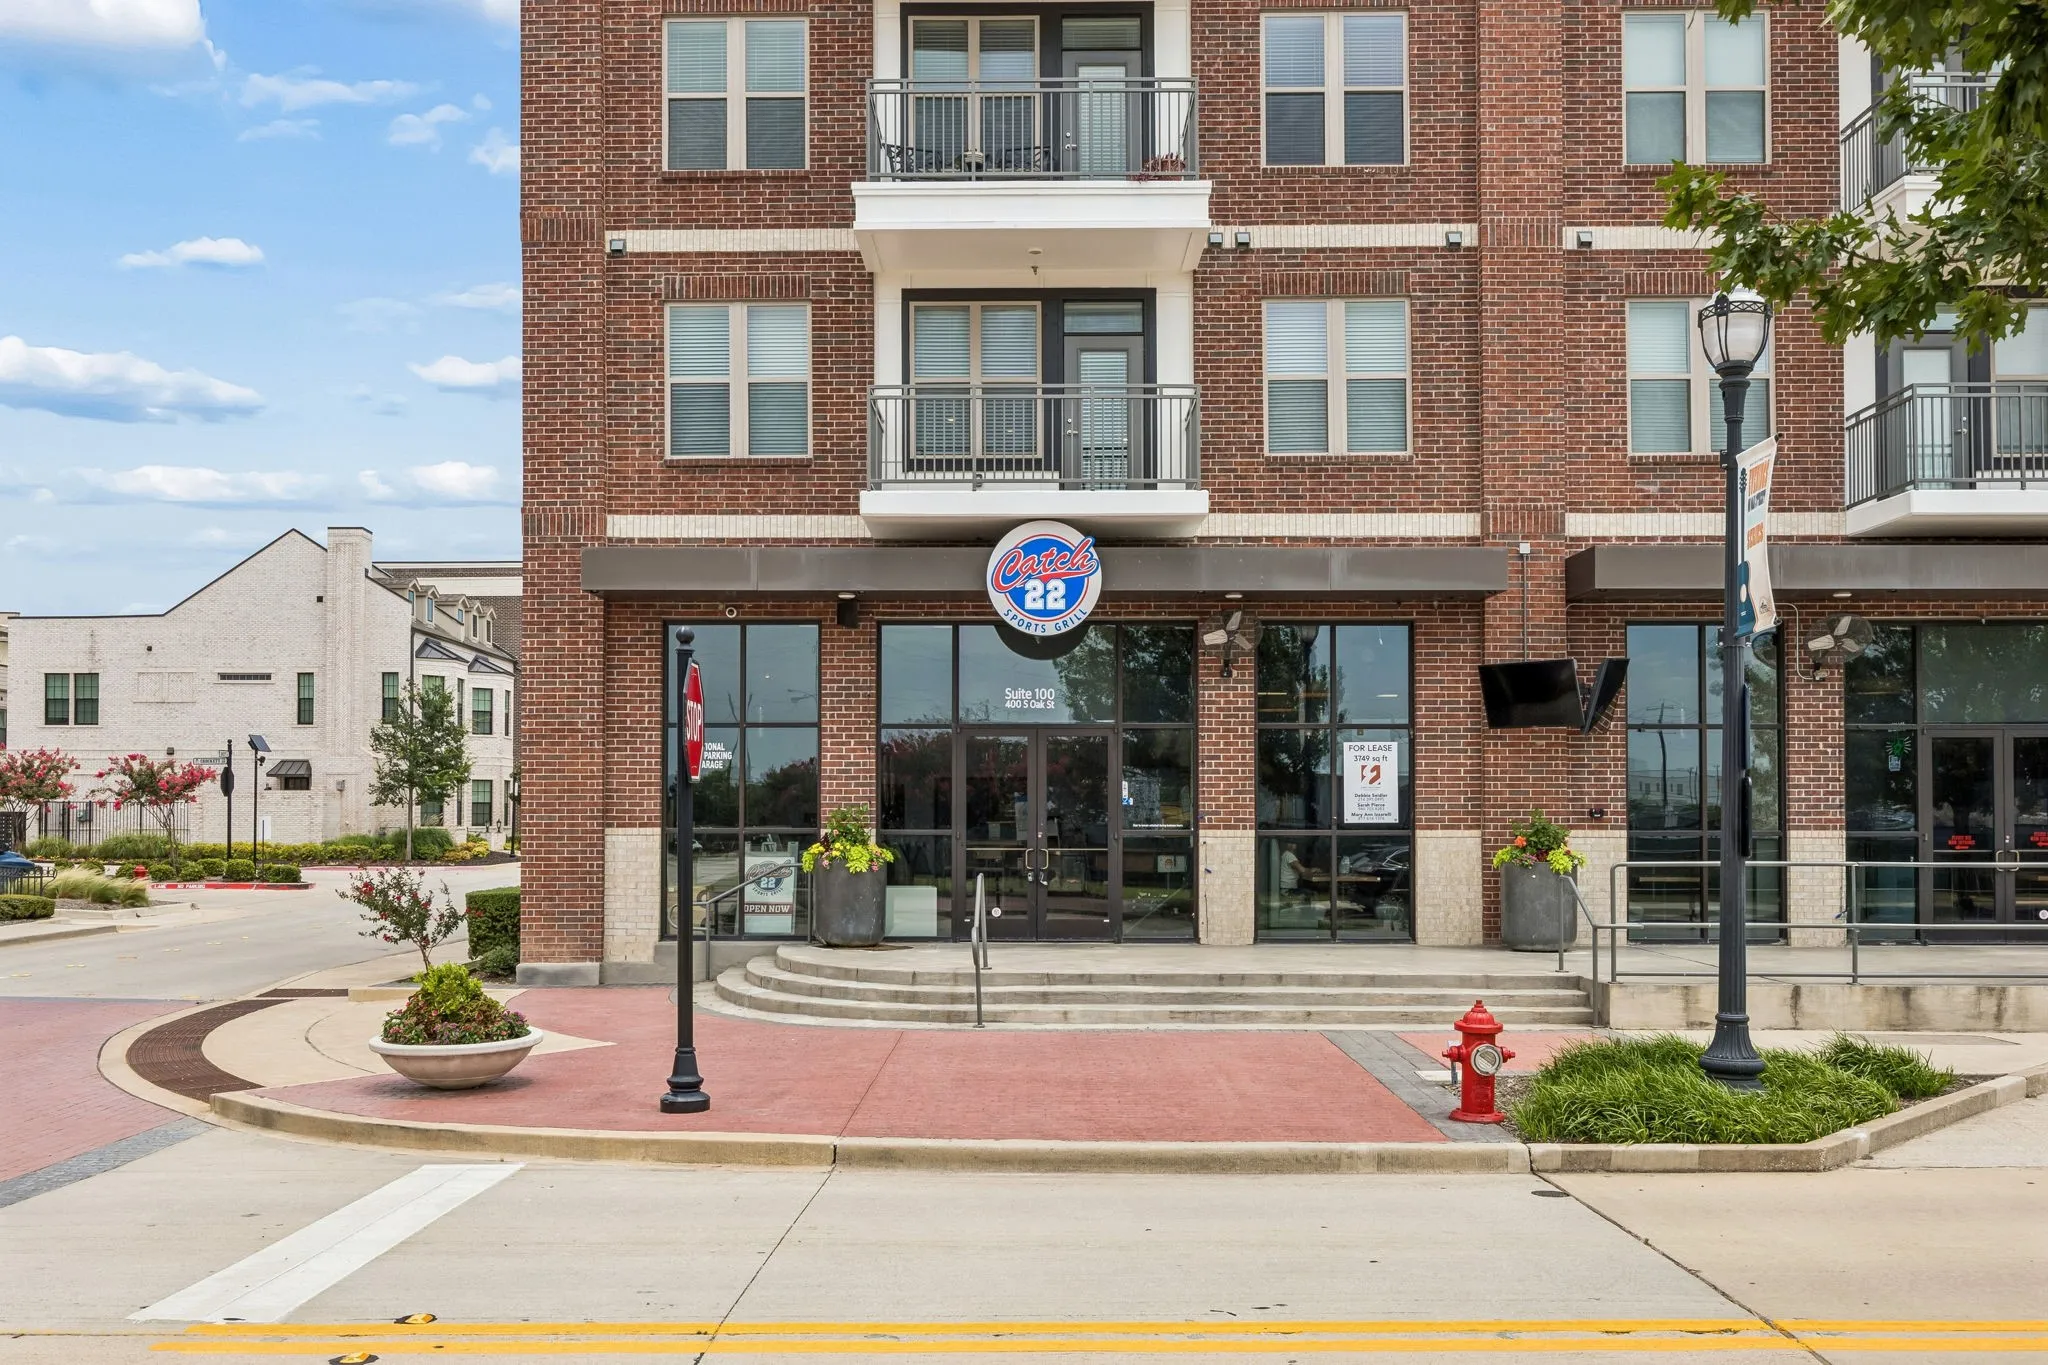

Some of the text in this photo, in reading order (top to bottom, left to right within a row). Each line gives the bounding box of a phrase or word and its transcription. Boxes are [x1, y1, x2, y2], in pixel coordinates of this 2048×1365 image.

[992, 536, 1097, 592] Catch
[1024, 578, 1066, 610] 22
[1003, 609, 1087, 633] SPORTS GRILL
[1005, 687, 1055, 700] Suite 100
[1005, 700, 1055, 709] 400 S Oak St
[686, 699, 702, 742] STOP
[1348, 744, 1393, 752] FOR LEASE
[704, 751, 733, 760] PARKING
[1382, 754, 1388, 762] ft
[701, 760, 724, 769] ARAGE
[760, 877, 776, 888] 22
[744, 904, 791, 913] OPEN NOW
